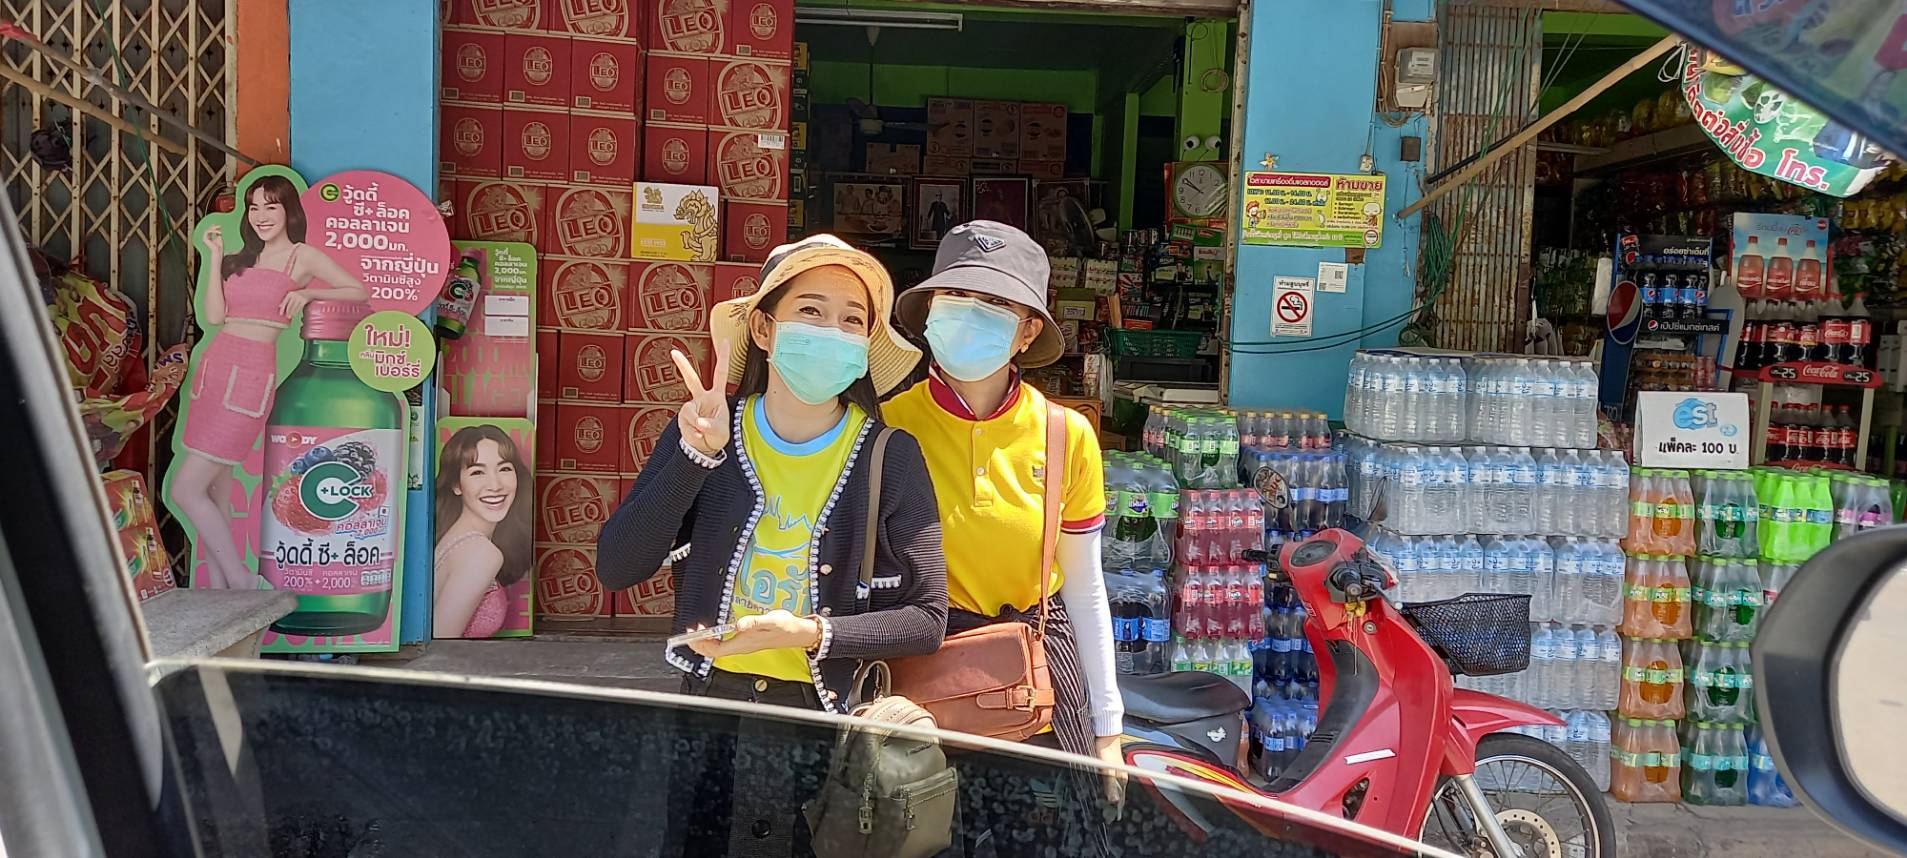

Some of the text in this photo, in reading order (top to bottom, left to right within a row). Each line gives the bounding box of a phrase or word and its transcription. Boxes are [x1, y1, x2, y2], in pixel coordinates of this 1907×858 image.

[665, 10, 718, 40] LEO
[752, 15, 775, 26] LEO
[459, 58, 483, 68] LEO
[526, 60, 549, 70] LEO
[592, 65, 616, 77] LEO
[666, 80, 688, 90] LEO
[723, 85, 776, 114] LEO
[456, 133, 480, 143] LEO
[524, 136, 548, 146] LEO
[590, 141, 614, 152] LEO
[664, 151, 687, 161] LEO
[722, 156, 776, 185] LEO
[1774, 147, 1829, 191] โทร.
[343, 182, 379, 204] วู้ดดี้
[376, 201, 410, 219] ล็อค
[325, 217, 410, 233] คอลลาเจน
[474, 207, 531, 236] LEO
[562, 212, 620, 243] LEO
[745, 226, 768, 236] LEO
[360, 252, 439, 278] จากญี่ปุ่น
[362, 272, 421, 288] วิตามินซีสูง
[558, 285, 614, 316] LEO
[645, 286, 700, 317] LEO
[364, 323, 410, 348] ใหม่!
[375, 359, 420, 378] เบอร์รี่
[580, 358, 604, 369] LEO
[1802, 363, 1840, 379] Coca-Cola
[1781, 367, 1797, 379] 25
[1854, 371, 1871, 383] 25
[1673, 399, 1719, 430] est
[578, 429, 602, 440] LEO
[1659, 437, 1698, 454] แพ็คละ
[1702, 441, 1724, 455] 100
[549, 500, 604, 529] LEO
[275, 538, 314, 569] วู้ดดี้
[343, 540, 380, 566] ล็อค
[543, 572, 597, 600] LEO
